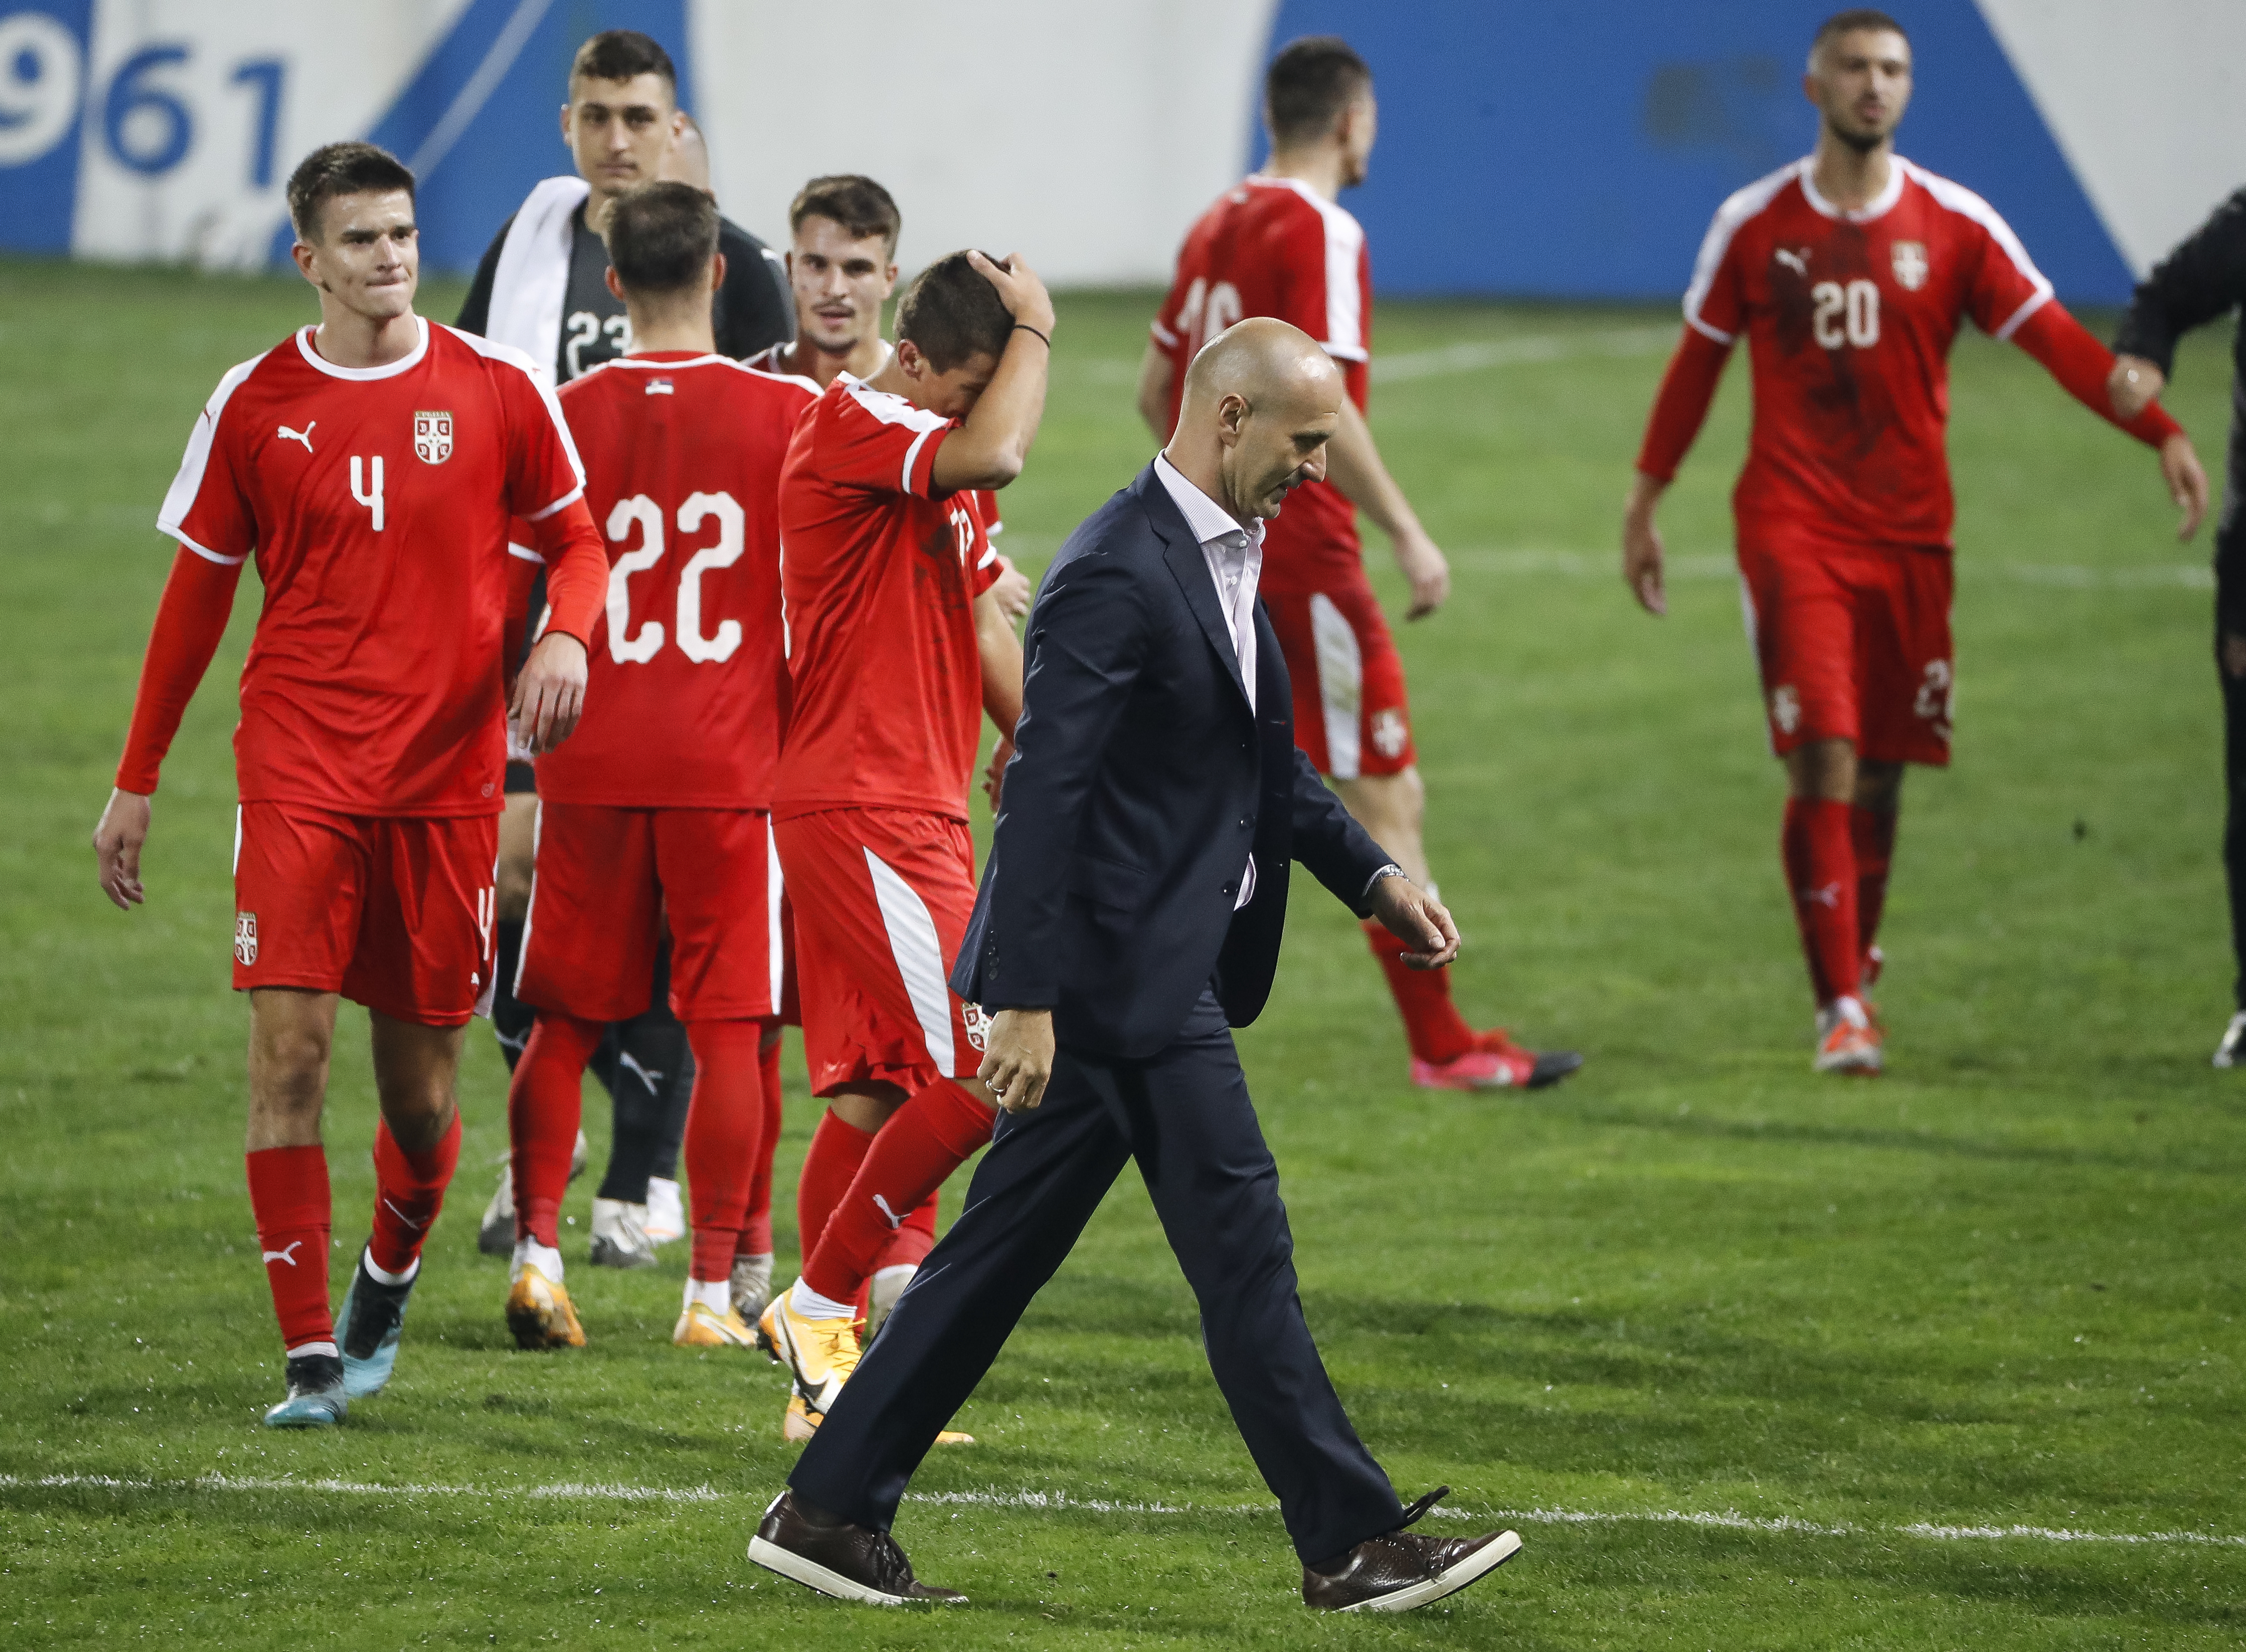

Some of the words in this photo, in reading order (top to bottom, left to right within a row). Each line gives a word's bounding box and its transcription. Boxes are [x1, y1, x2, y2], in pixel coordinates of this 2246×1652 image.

[1812, 280, 1880, 348] 20
[350, 456, 384, 531] 4
[606, 491, 745, 664] 22
[478, 886, 495, 961] 4
